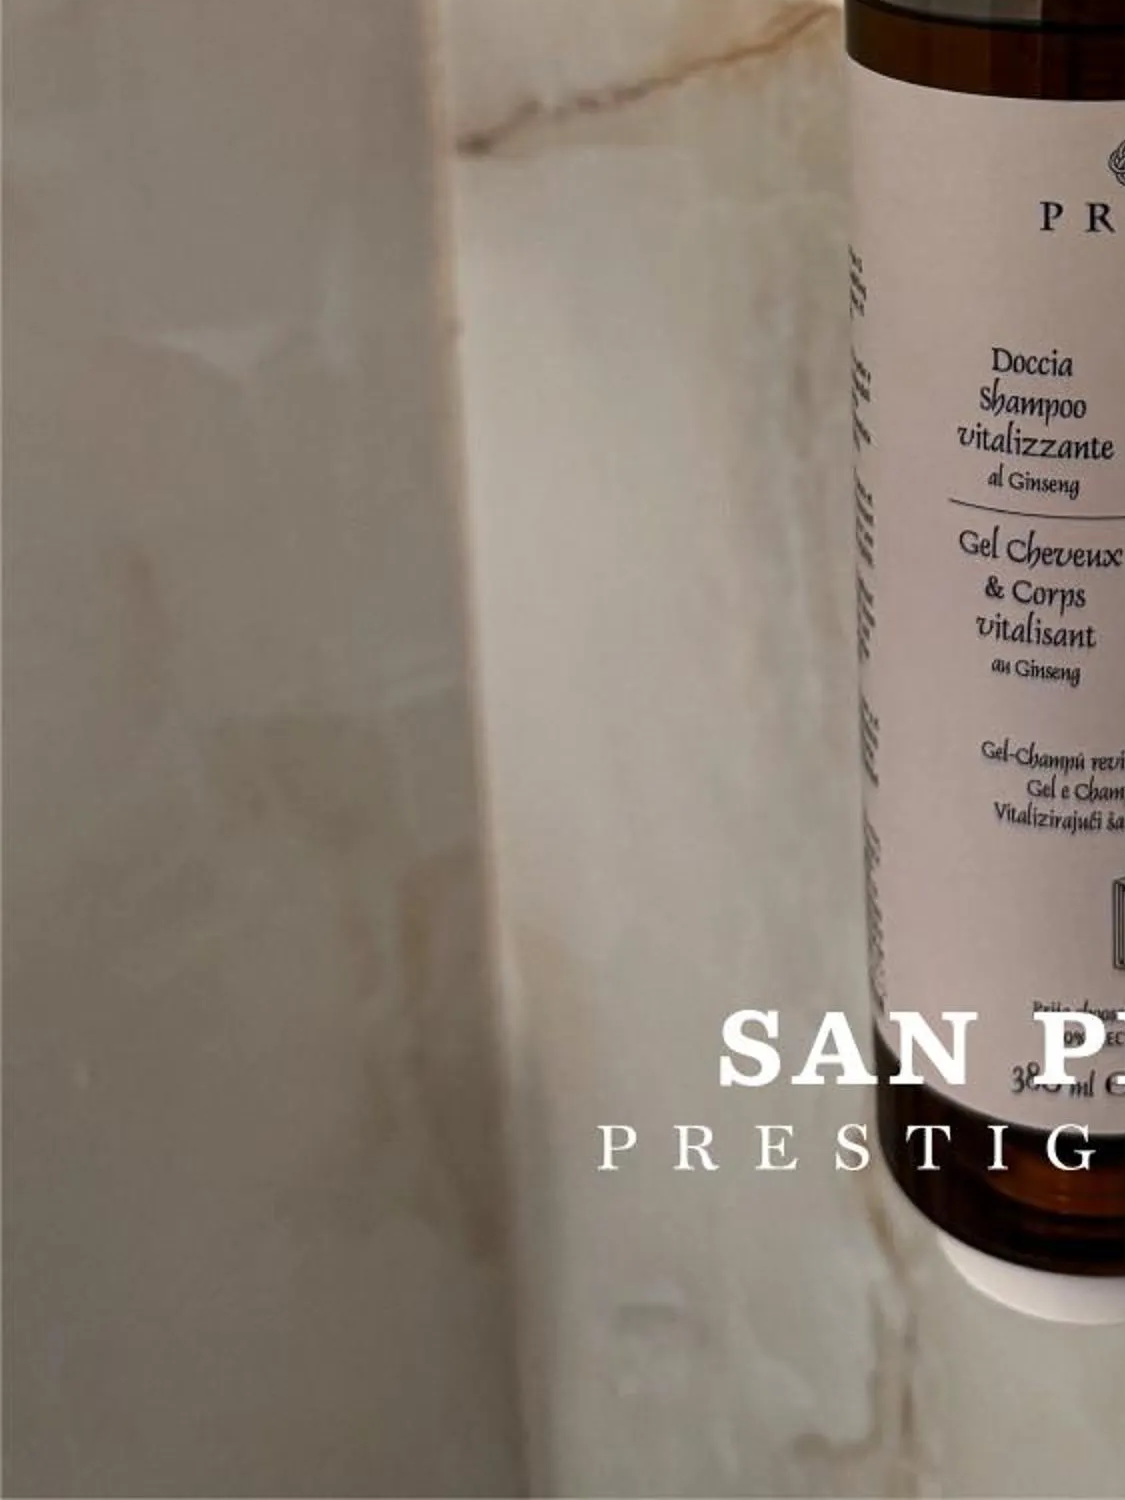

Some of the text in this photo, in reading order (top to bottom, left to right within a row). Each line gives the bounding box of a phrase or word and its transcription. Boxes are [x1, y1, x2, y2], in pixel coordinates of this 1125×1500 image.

[991, 347, 1073, 376] Doccia
[979, 378, 1087, 425] Shampoo
[957, 421, 1115, 461] vitalizzante
[988, 464, 1080, 499] al Ginseng
[959, 525, 1124, 570] Gel Cheveux
[985, 575, 1087, 616] & Corps
[976, 611, 1097, 648] vitalisant
[1015, 659, 1082, 687] Ginseng
[1026, 774, 1056, 798] Gel
[1061, 785, 1070, 799] e
